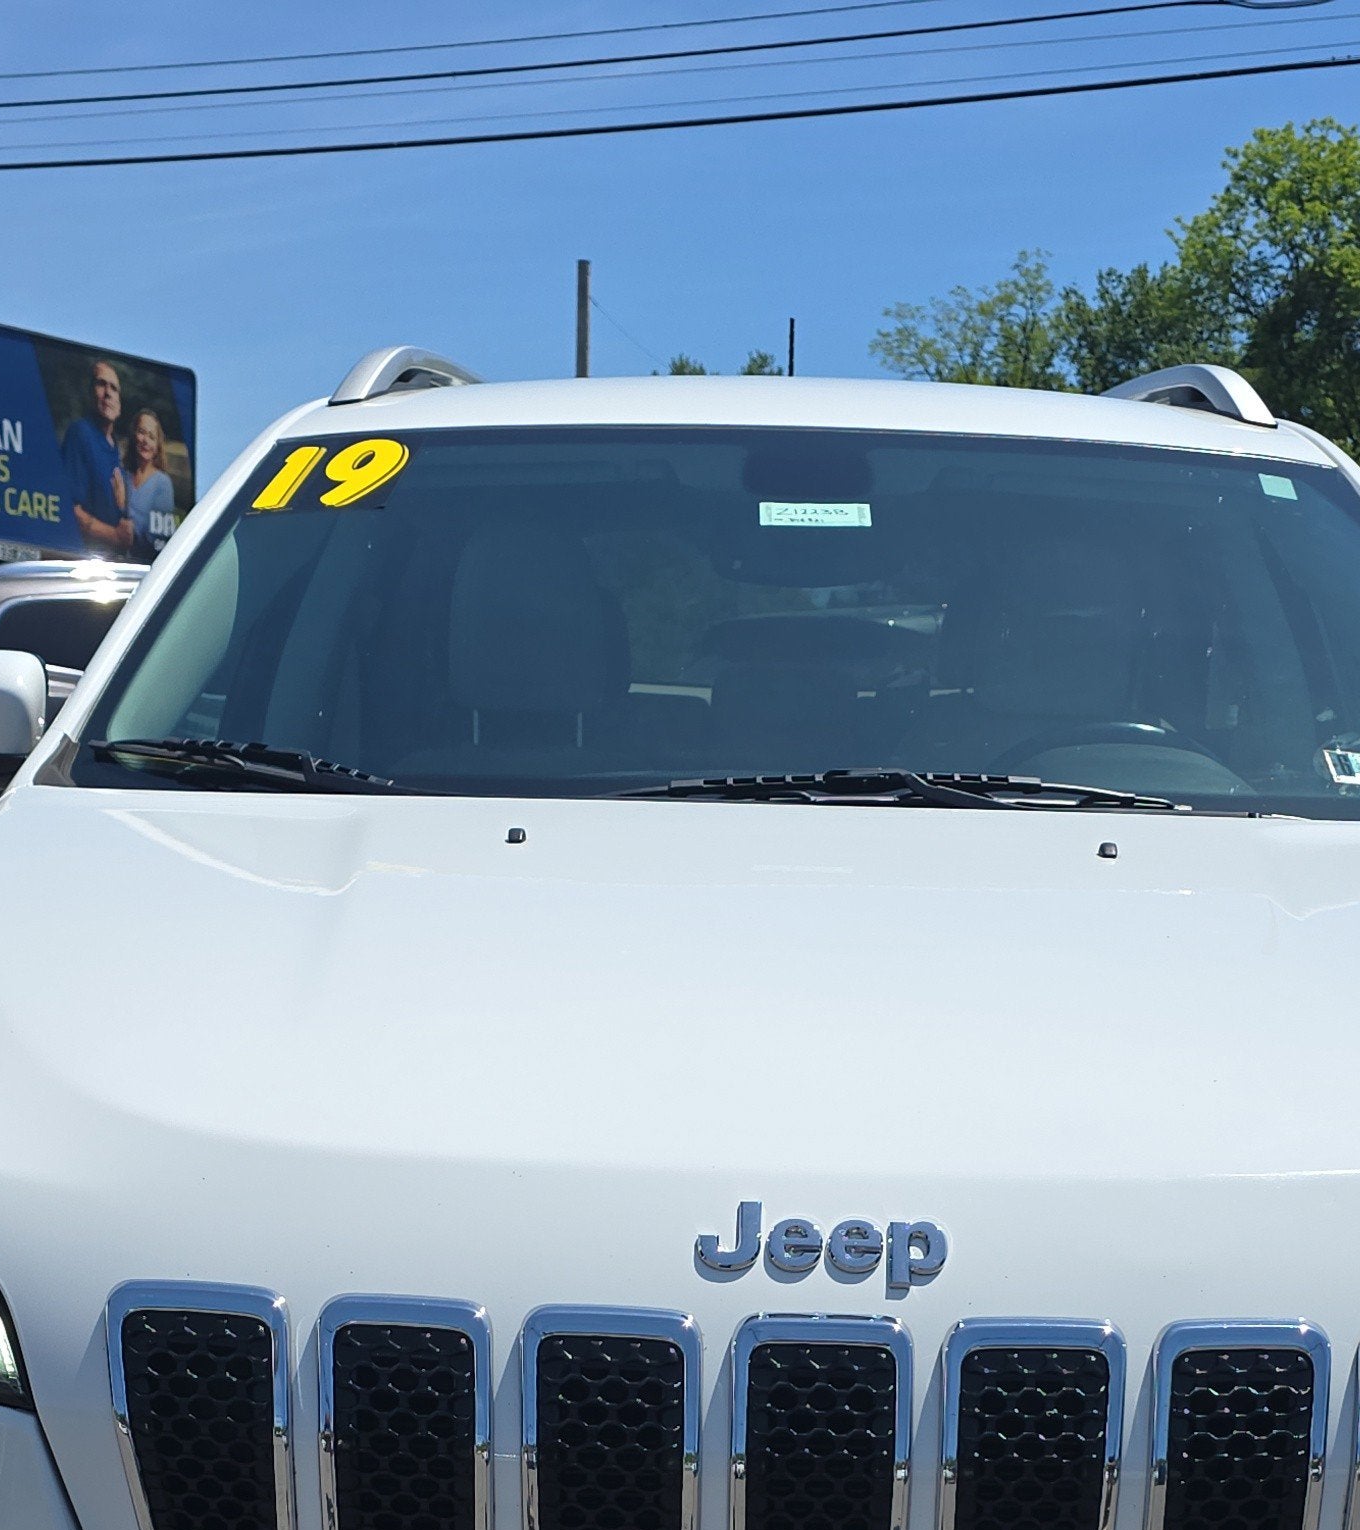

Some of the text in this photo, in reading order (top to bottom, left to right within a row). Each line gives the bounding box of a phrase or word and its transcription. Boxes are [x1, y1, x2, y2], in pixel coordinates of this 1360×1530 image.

[4, 487, 61, 524] CARE
[251, 439, 410, 510] 19
[695, 1201, 949, 1289] Jeep
